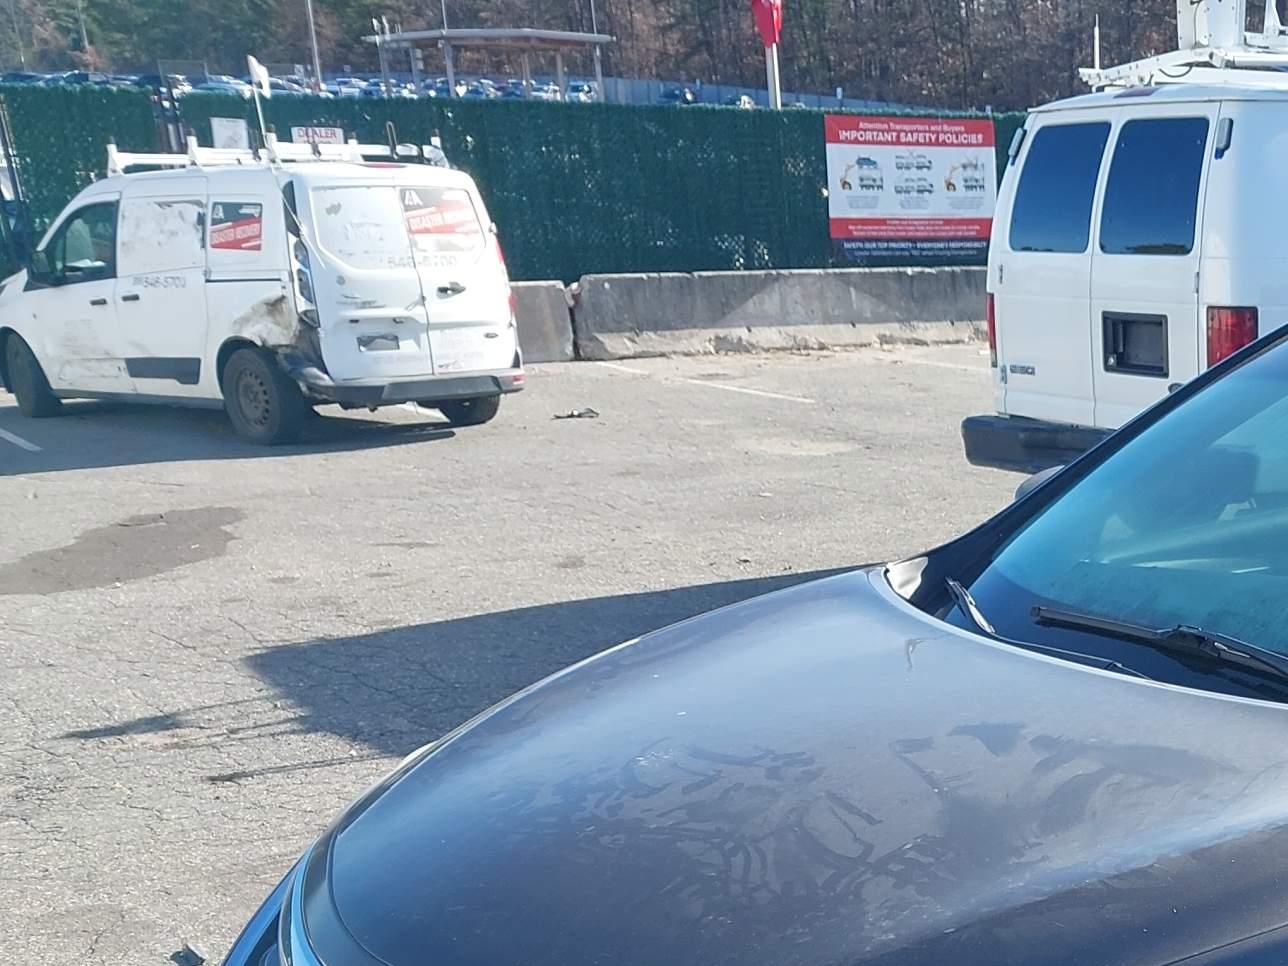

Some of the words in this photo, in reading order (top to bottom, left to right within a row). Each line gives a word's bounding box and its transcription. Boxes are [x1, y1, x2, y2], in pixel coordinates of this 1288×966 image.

[858, 121, 889, 130] Attention
[889, 122, 929, 132] Transporters
[943, 123, 965, 133] Buyers
[297, 128, 337, 139] DEALER
[839, 129, 897, 142] IMPORTANT
[899, 132, 937, 144] SAFETY
[938, 133, 984, 145] POLICIES
